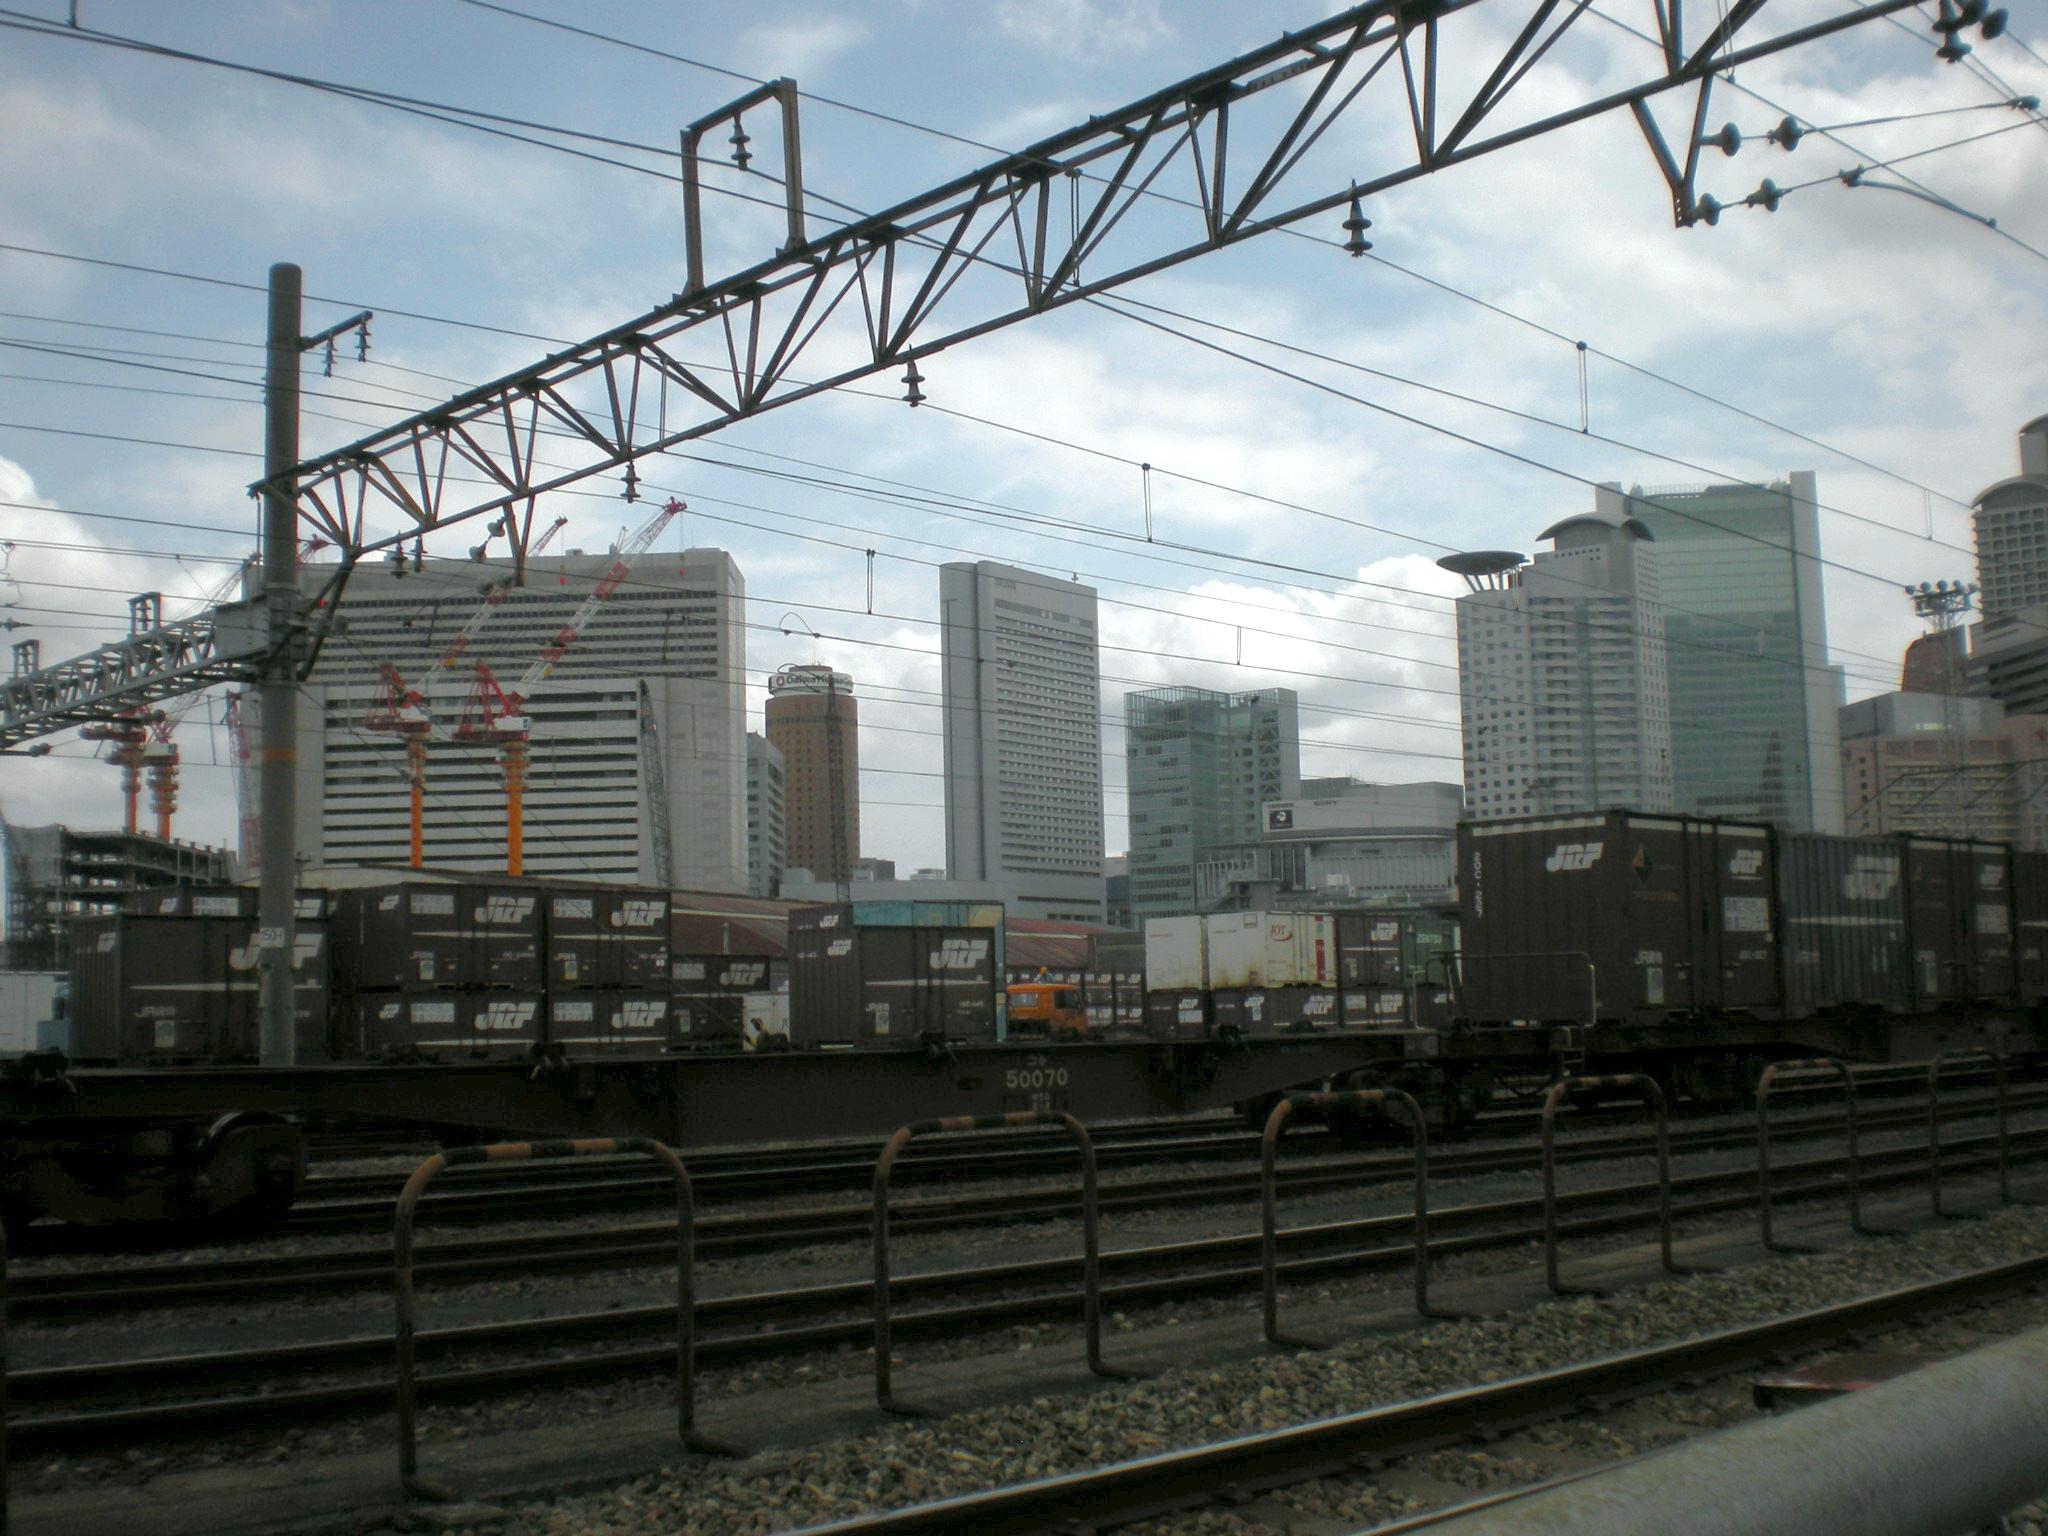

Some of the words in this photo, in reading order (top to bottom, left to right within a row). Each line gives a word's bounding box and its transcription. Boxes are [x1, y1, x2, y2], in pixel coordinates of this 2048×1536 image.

[1545, 842, 1604, 872] JRF
[474, 895, 536, 923] JRF
[611, 900, 667, 926] JRF
[229, 933, 323, 970] JF
[929, 939, 989, 969] JRF
[720, 963, 765, 986] JRF
[474, 1002, 537, 1030] JRF
[611, 1001, 667, 1028] JRF
[1006, 1067, 1069, 1089] 50070
